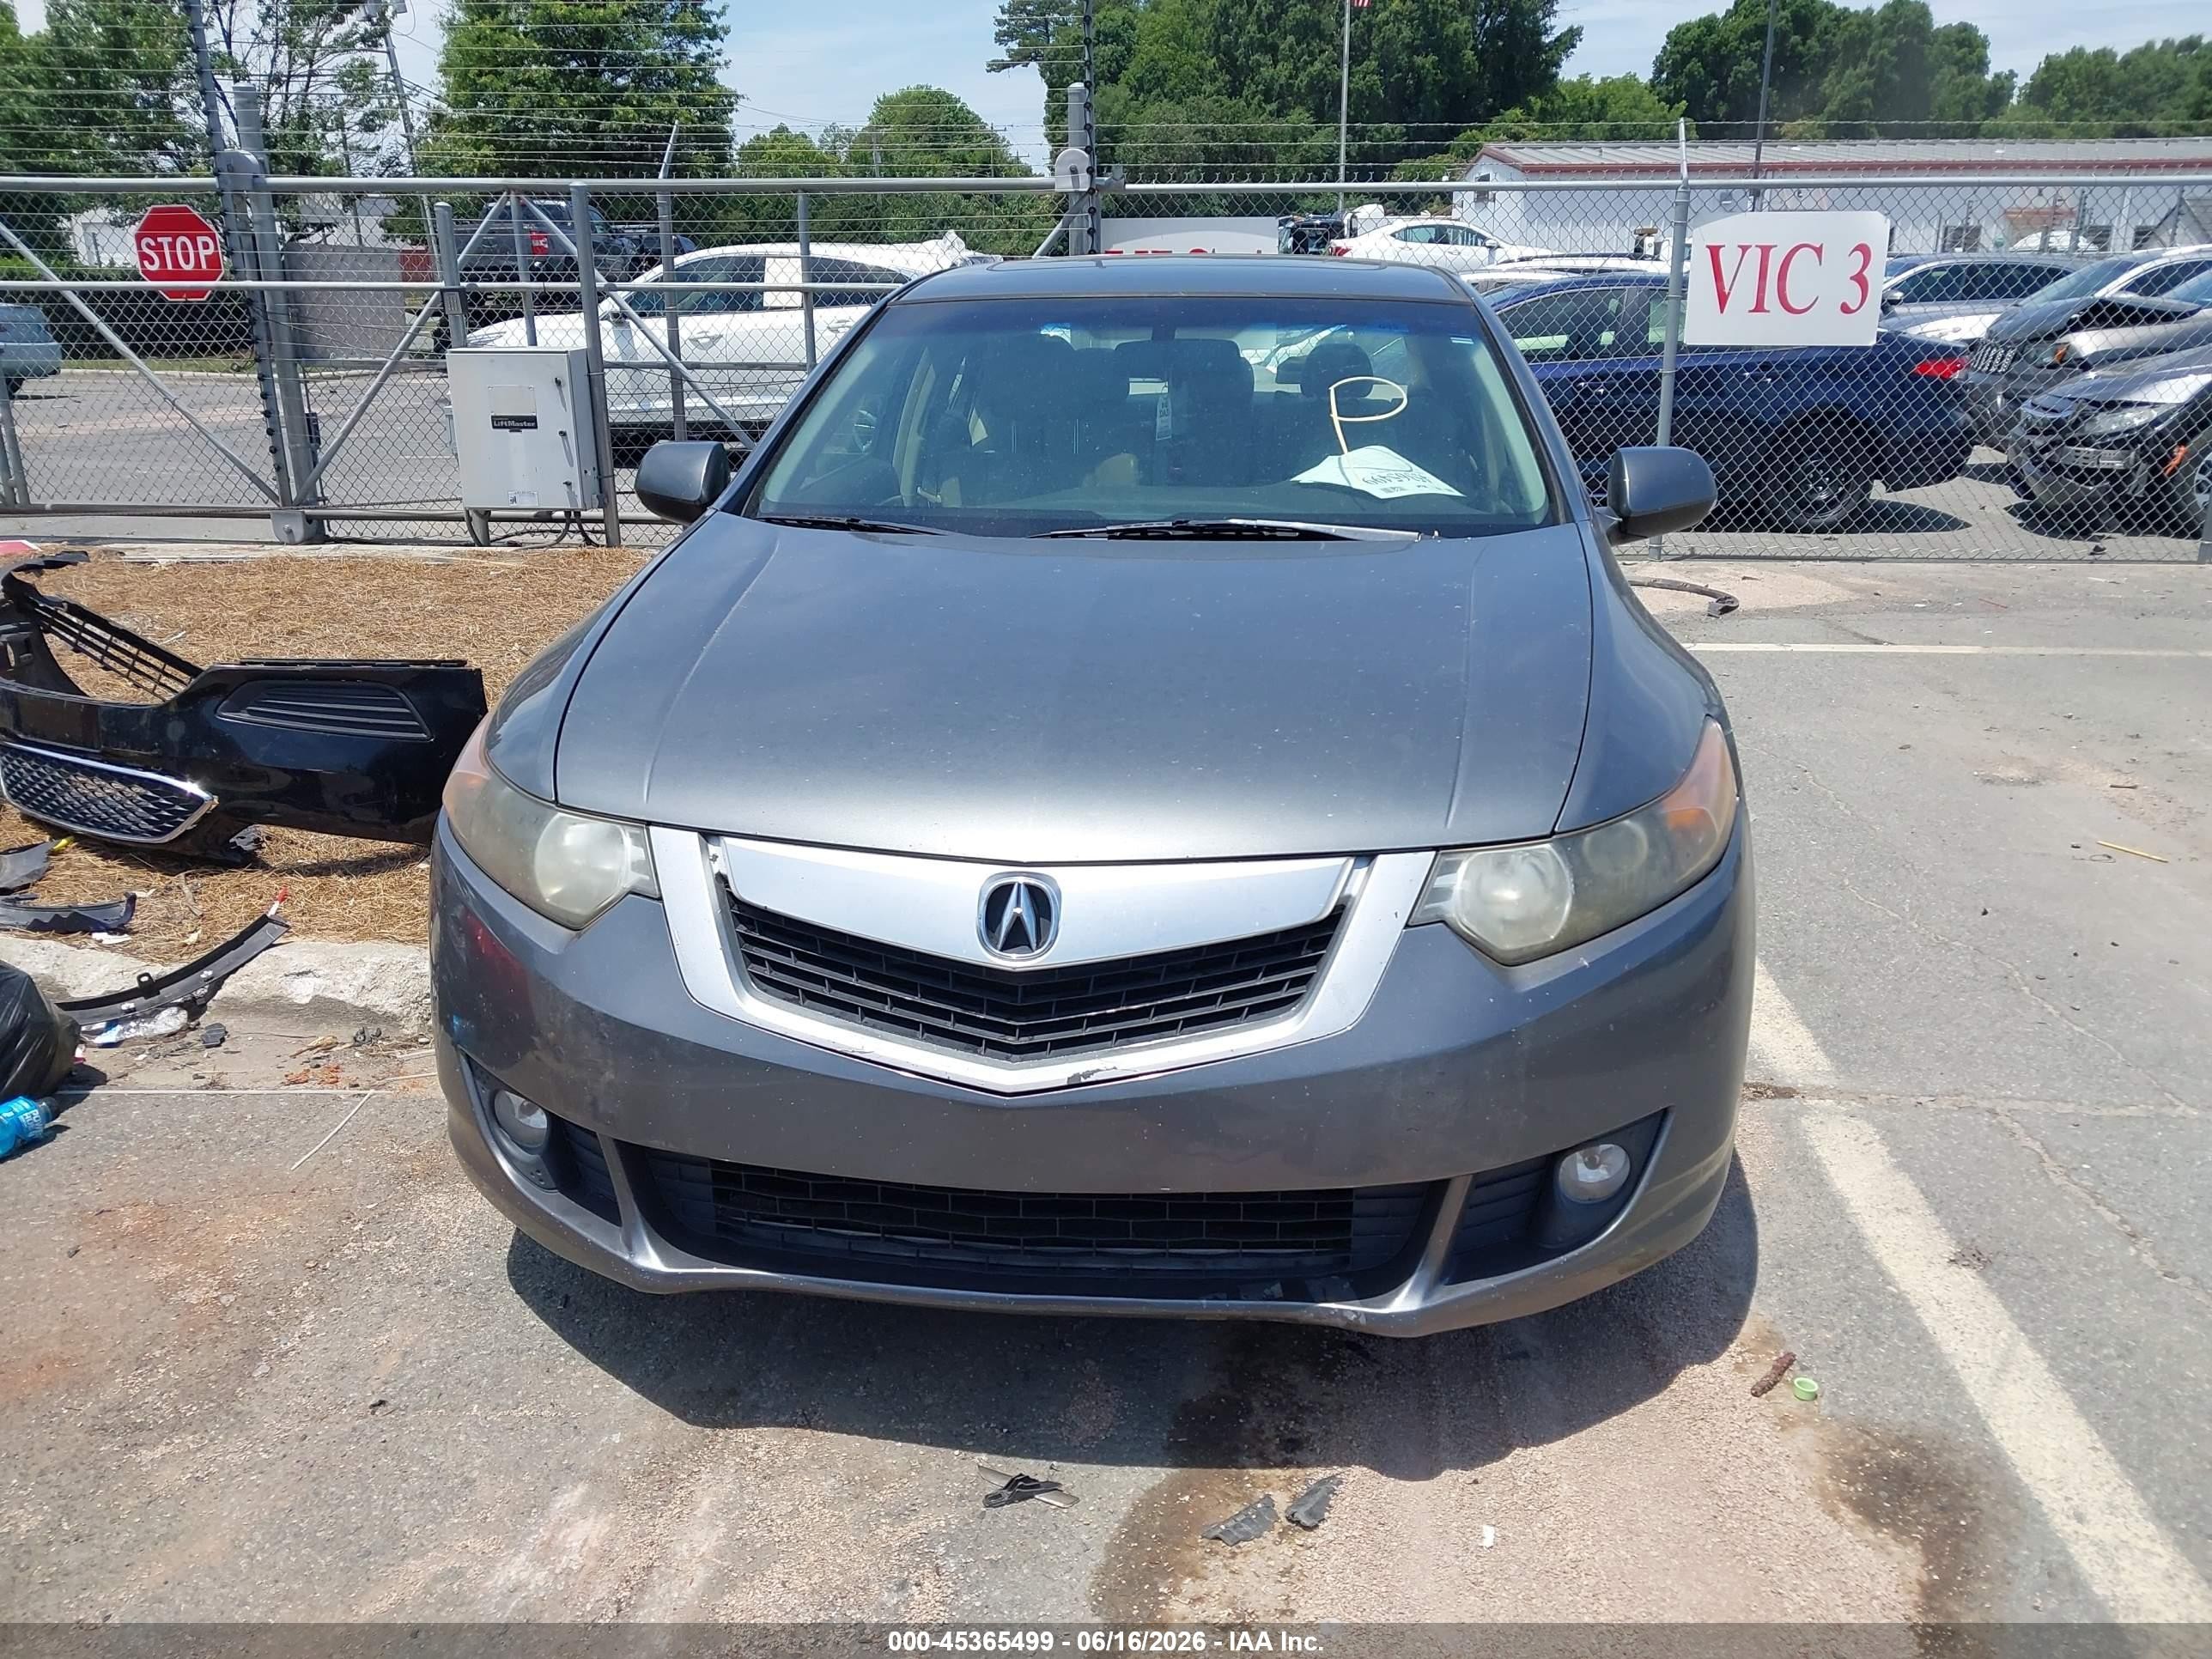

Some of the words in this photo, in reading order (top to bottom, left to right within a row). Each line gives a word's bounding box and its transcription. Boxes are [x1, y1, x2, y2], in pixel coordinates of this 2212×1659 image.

[140, 235, 215, 270] STOP
[1705, 243, 1824, 315] VIC
[1839, 242, 1872, 315] 3
